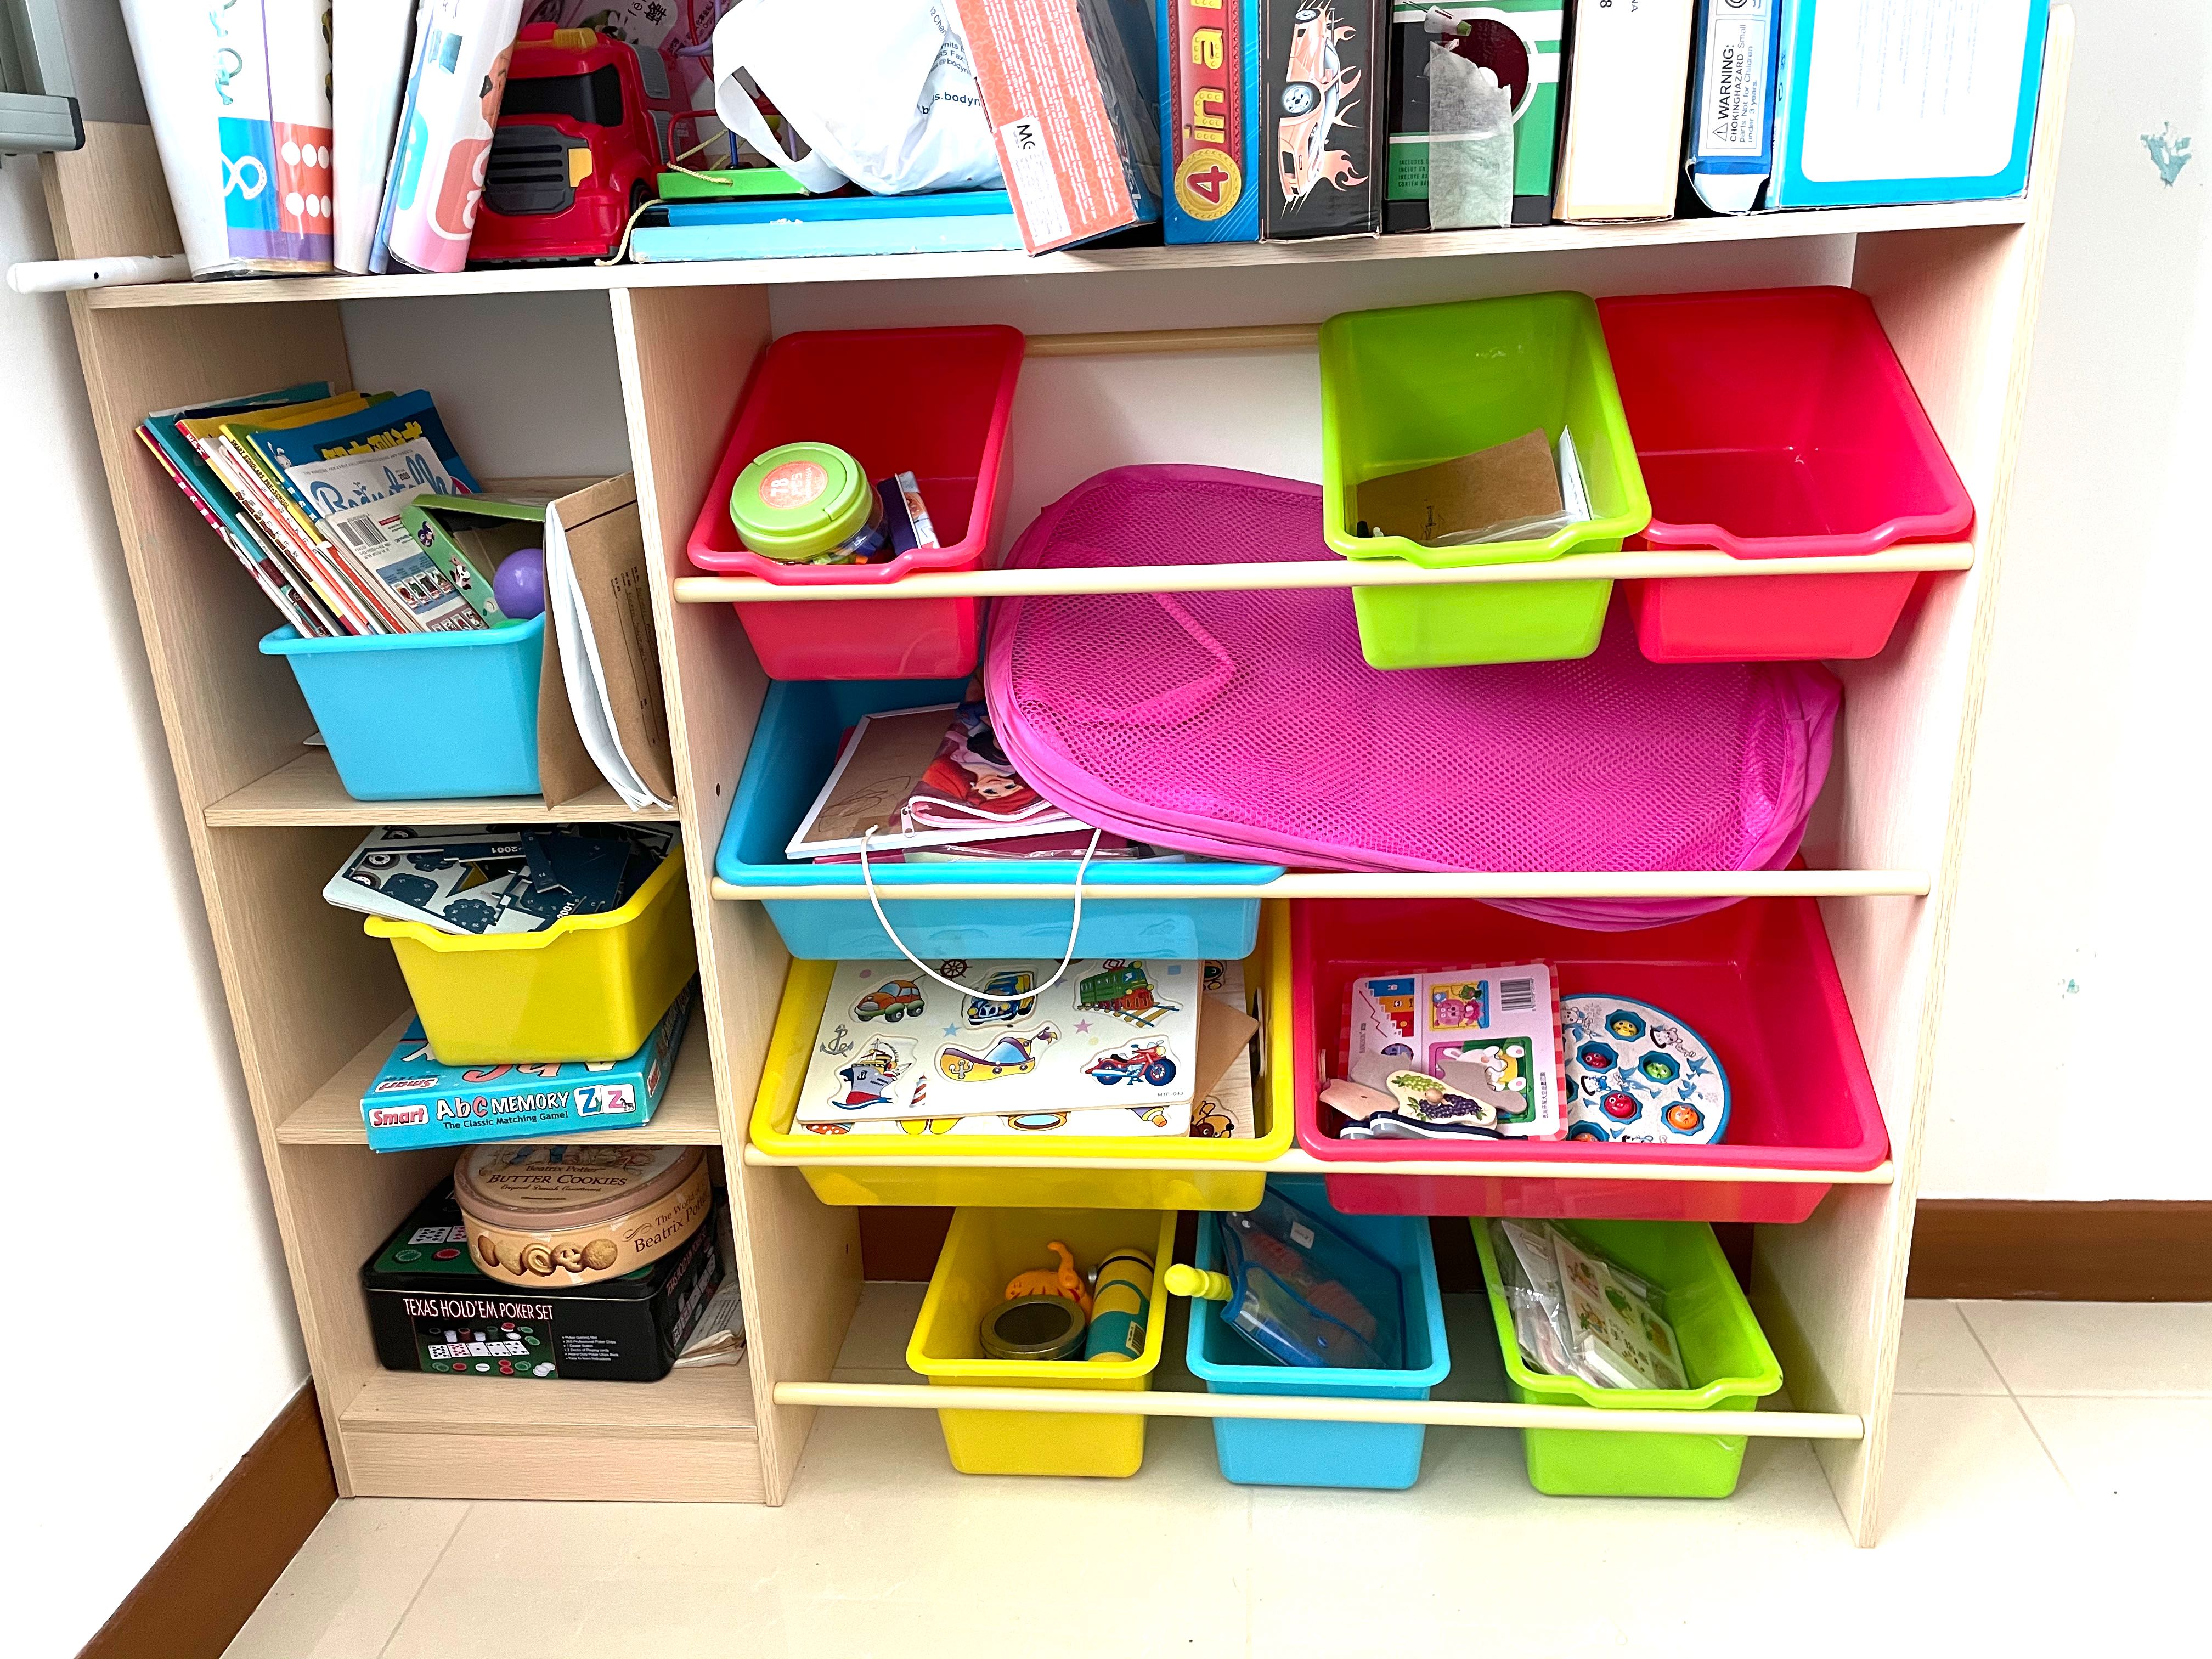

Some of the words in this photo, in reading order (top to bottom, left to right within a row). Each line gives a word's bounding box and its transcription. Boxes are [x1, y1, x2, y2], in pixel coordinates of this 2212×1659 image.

[1738, 24, 1746, 48] Small
[1192, 28, 1223, 69] a
[1744, 46, 1753, 82] Children
[1718, 44, 1735, 120] WARNING:
[1184, 88, 1224, 143] in
[1186, 166, 1228, 205] 4
[770, 478, 789, 497] 78
[491, 1091, 570, 1115] MEMORY
[373, 1108, 425, 1126] Smart
[464, 1119, 493, 1128] Classic
[496, 1114, 537, 1125] Matching
[487, 1175, 552, 1184] BUTTER
[557, 1175, 628, 1186] COOKIES
[634, 1218, 684, 1252] Beatrix
[686, 1197, 707, 1224] Pott
[655, 1212, 672, 1226] The
[403, 1299, 438, 1317] TEXAS
[440, 1300, 498, 1318] HOLD'EM
[499, 1303, 535, 1319] POKER
[535, 1305, 552, 1320] SET
